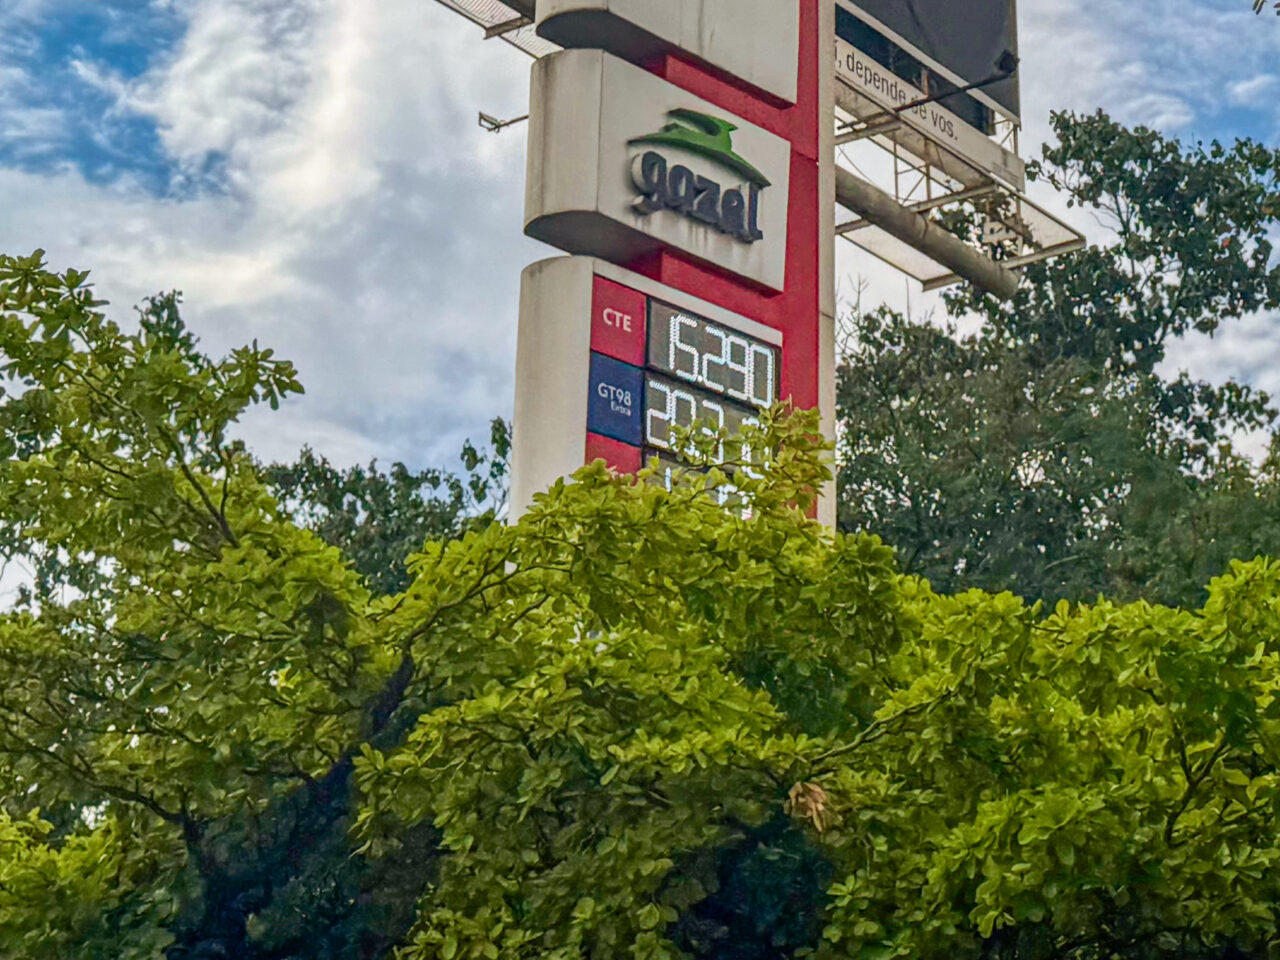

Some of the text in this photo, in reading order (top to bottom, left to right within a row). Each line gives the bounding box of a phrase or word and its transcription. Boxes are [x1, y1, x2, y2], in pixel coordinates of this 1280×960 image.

[846, 52, 906, 105] depende
[911, 94, 928, 120] de
[931, 108, 959, 141] vos.
[632, 151, 763, 242] gazel
[598, 383, 632, 406] GT98
[603, 308, 774, 409] CTE 15.290
